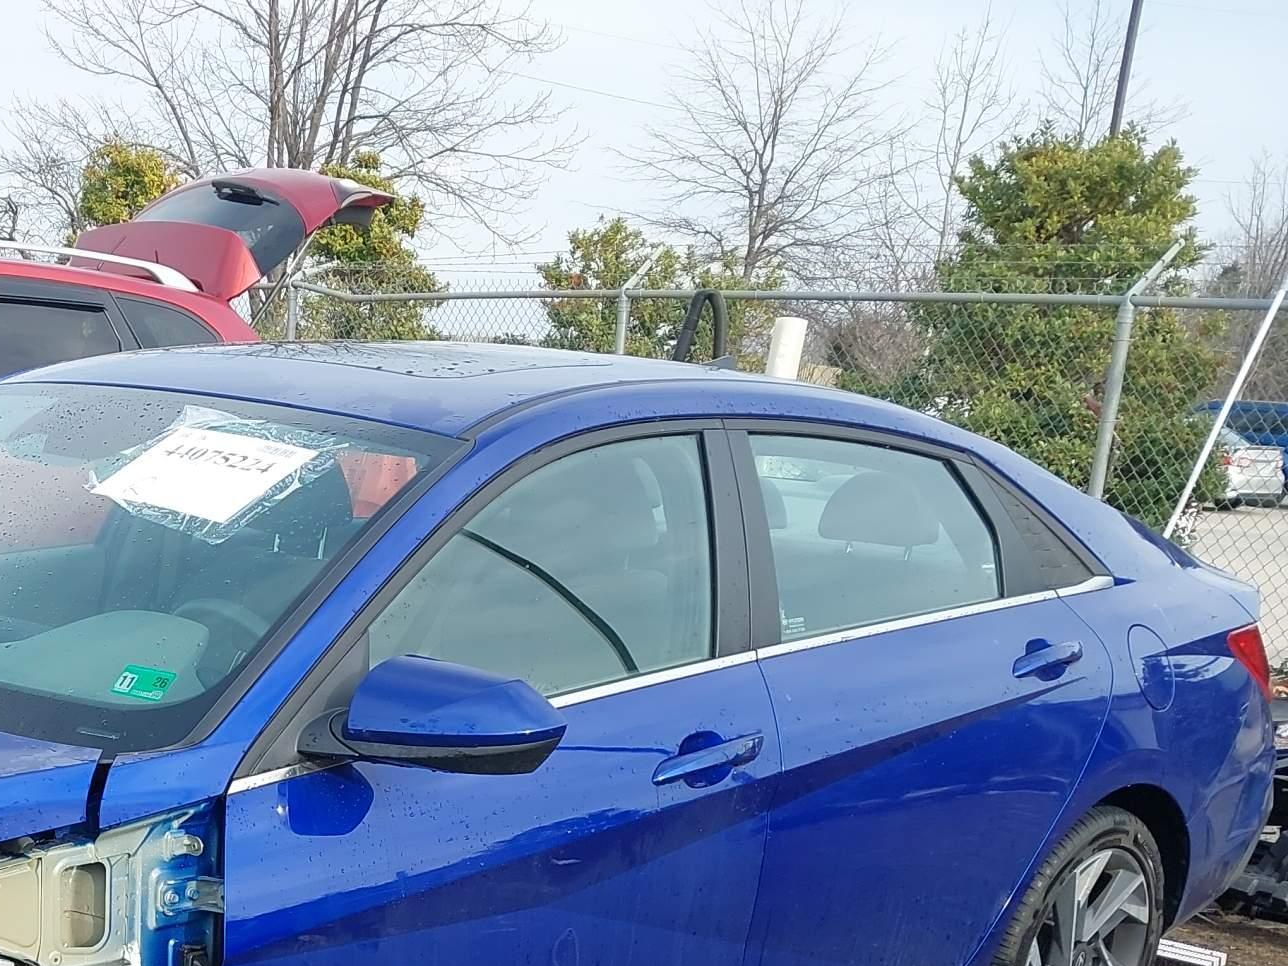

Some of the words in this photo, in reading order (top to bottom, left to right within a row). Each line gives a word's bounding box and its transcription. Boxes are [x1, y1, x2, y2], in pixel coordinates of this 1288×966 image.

[163, 443, 278, 474] 44075224
[118, 675, 134, 689] 11
[152, 676, 170, 689] 26
